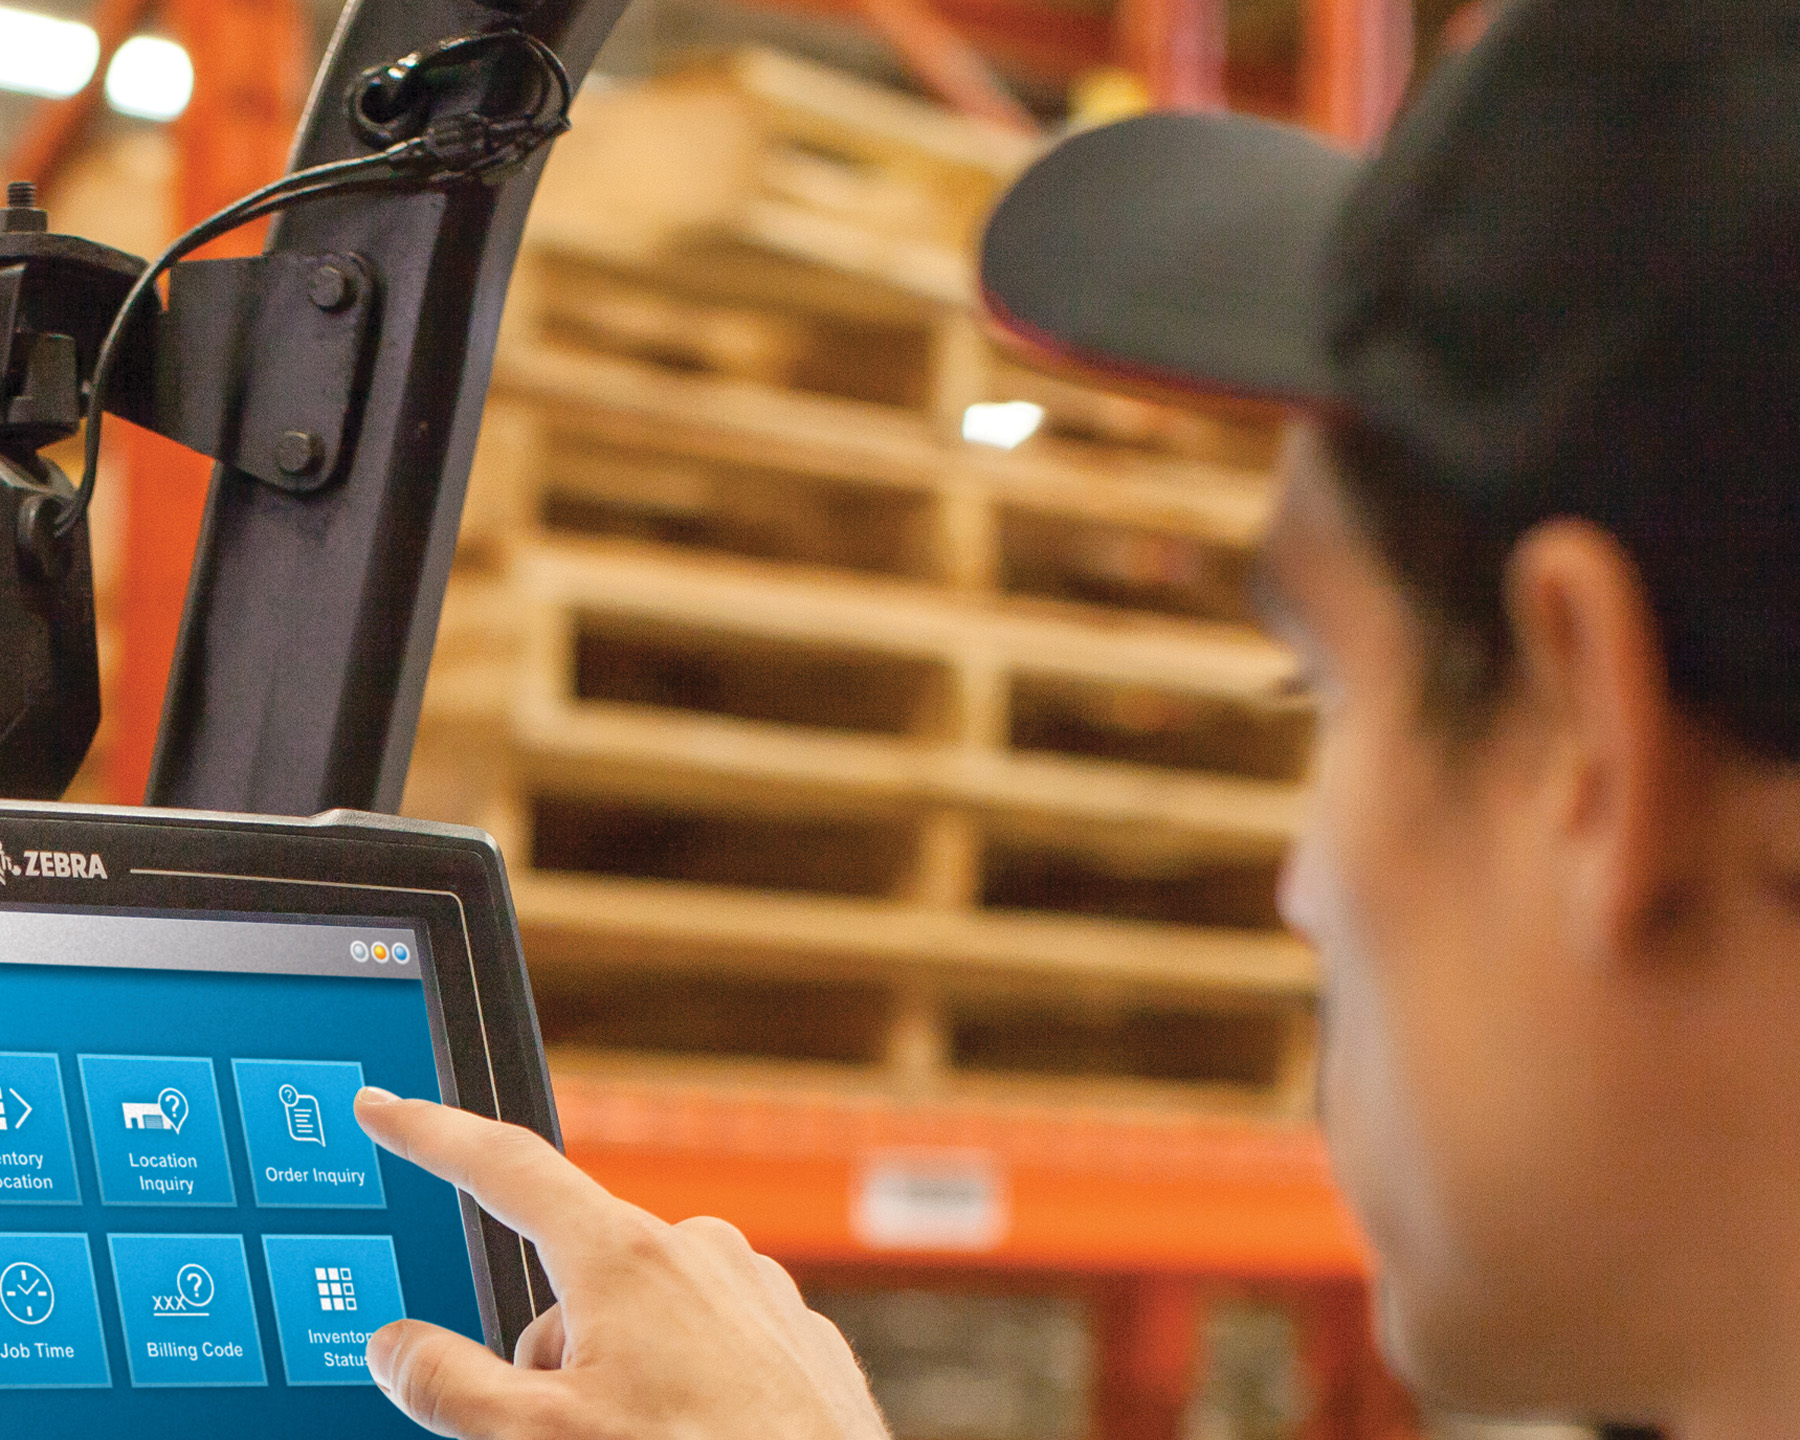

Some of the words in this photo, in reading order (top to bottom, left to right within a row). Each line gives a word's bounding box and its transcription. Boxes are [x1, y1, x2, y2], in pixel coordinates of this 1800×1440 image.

[23, 850, 108, 880] ZEBRA
[129, 1152, 198, 1168] Location
[139, 1175, 194, 1195] Inquiry
[265, 1167, 308, 1182] Order
[313, 1167, 365, 1186] Inquiry
[308, 1329, 374, 1344] Inventor
[0, 1343, 30, 1358] Job
[35, 1342, 74, 1358] Time
[147, 1342, 198, 1361] Billing
[202, 1341, 243, 1357] Code
